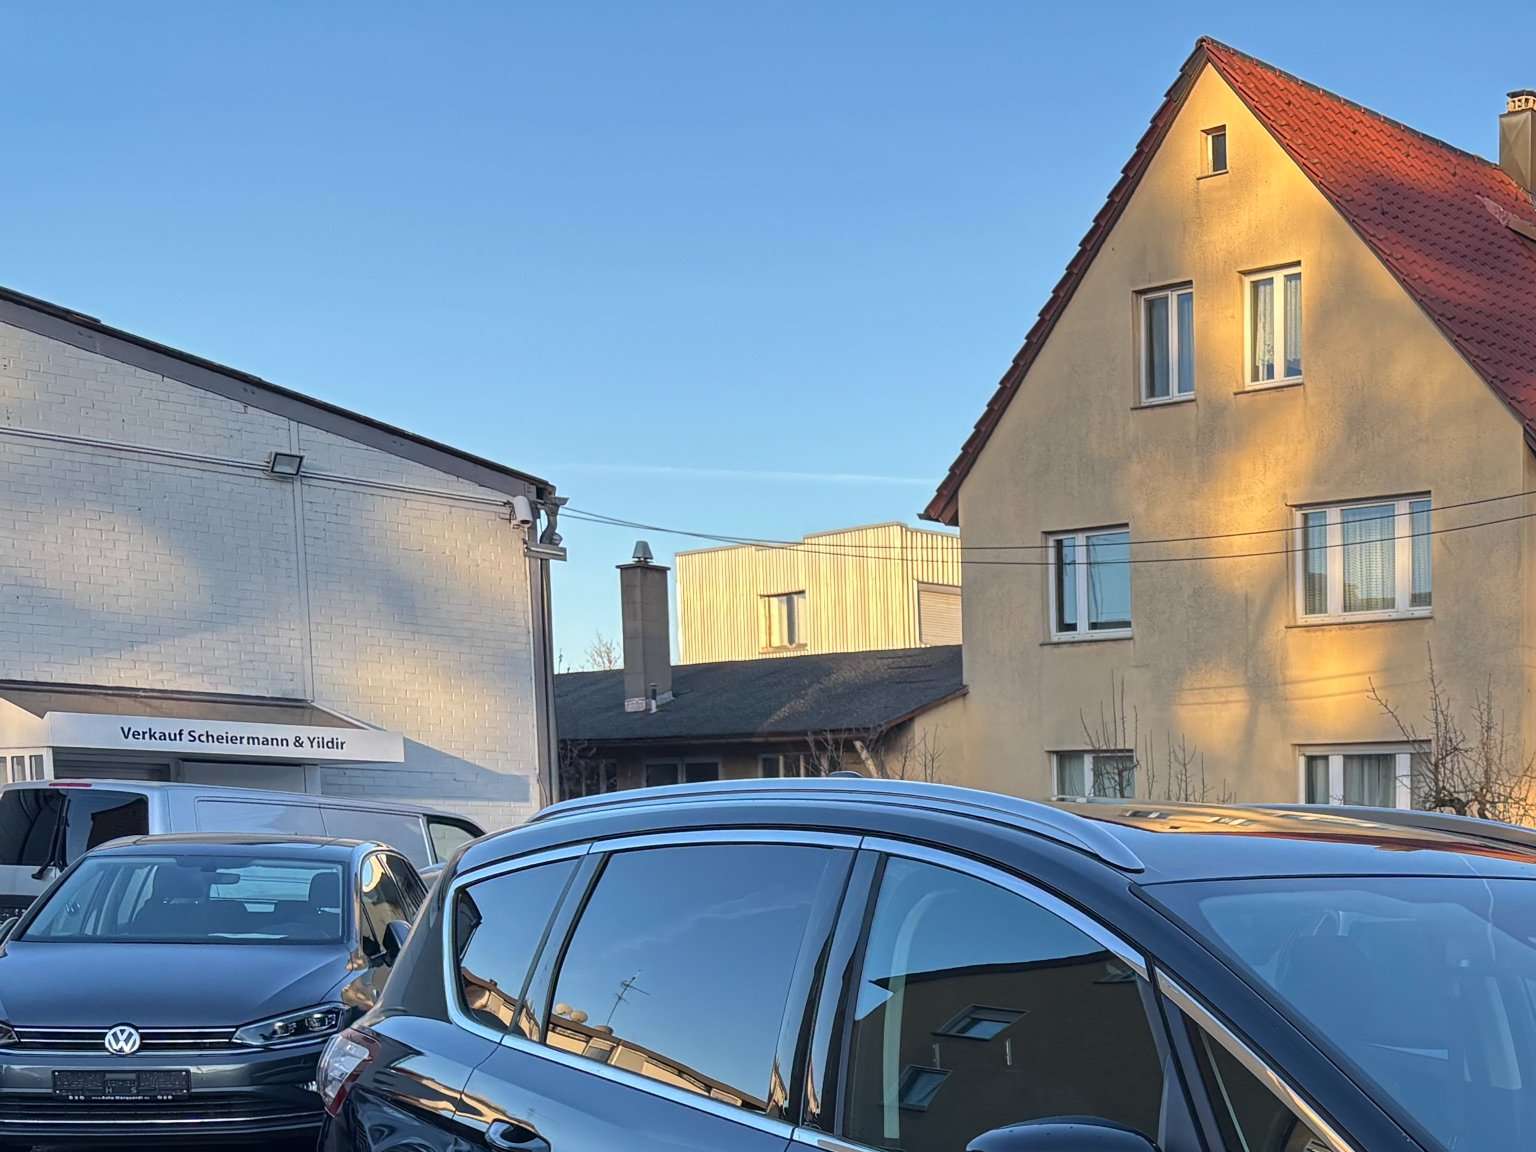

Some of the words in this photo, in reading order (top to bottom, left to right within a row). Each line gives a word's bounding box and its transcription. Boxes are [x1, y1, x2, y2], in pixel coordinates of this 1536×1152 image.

[120, 726, 185, 742] Verkauf
[188, 730, 289, 747] Scheiermann
[293, 735, 304, 748] &
[307, 736, 346, 750] Yildir
